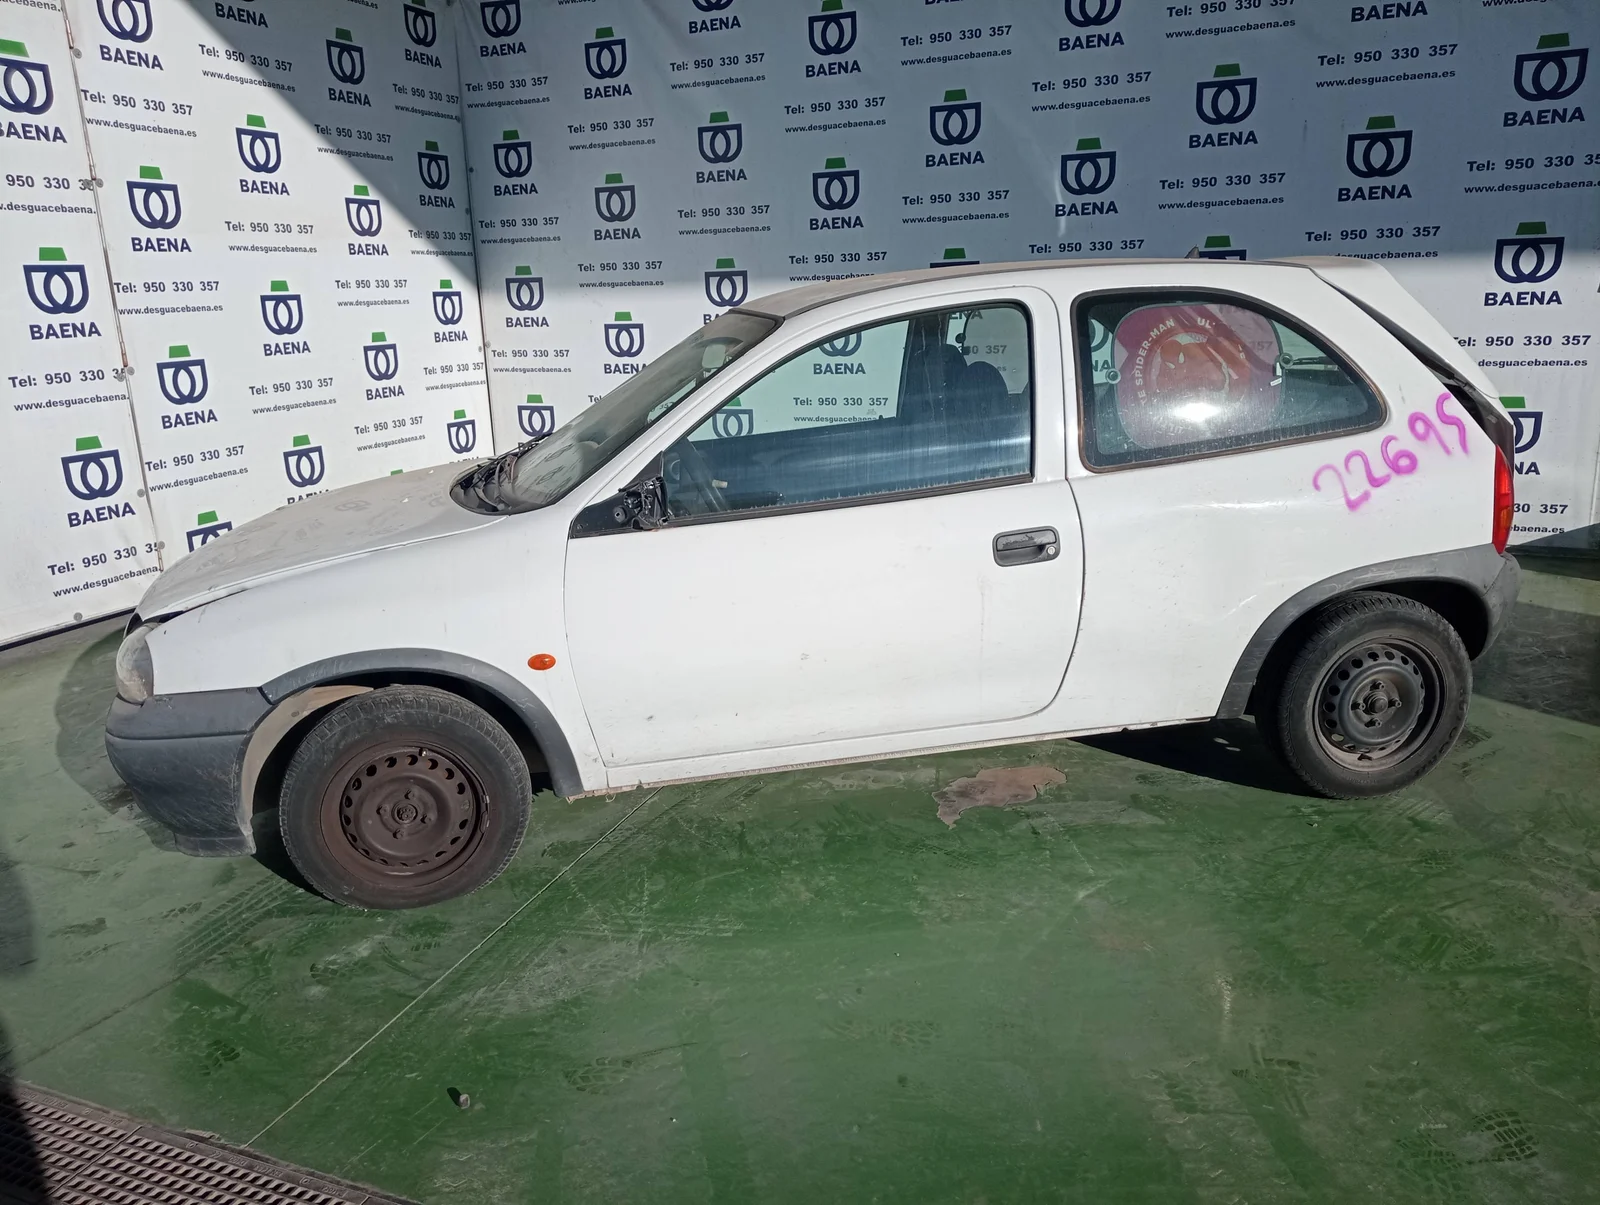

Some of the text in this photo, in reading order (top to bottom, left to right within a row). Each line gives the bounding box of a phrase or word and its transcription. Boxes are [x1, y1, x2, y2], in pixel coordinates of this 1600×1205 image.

[214, 2, 269, 29] BAENA
[1166, 5, 1193, 18] Tel:
[1200, 1, 1227, 14] 950
[1234, 0, 1261, 10] 330
[1350, 0, 1428, 23] BAENA
[688, 15, 742, 34] BAENA
[1165, 19, 1296, 39] www.desguacebaena.es
[900, 24, 1012, 47] Tel: 950 330 357
[1058, 31, 1125, 52] BAENA
[99, 44, 164, 71] BAENA
[198, 43, 293, 72] Tel: 950 330 357
[479, 41, 527, 58] BAENA
[900, 48, 1012, 66] www.desguacebaena.es
[1317, 43, 1459, 67] Tel: 950 330 357
[404, 48, 443, 69] BAENA
[669, 52, 765, 72] Tel: 950 330 357
[805, 59, 862, 78] BAENA
[201, 69, 296, 93] www.desguacebaena.es
[464, 75, 549, 92] Tel: 950 330 357
[670, 74, 766, 90] www.desguacebaena.es
[1031, 71, 1152, 93] Tel: 950 330 357
[1315, 70, 1456, 88] www.desguacebaena.es
[327, 87, 372, 108] BAENA
[583, 83, 633, 100] BAENA
[82, 88, 193, 116] Tel: 950 330 357
[466, 96, 551, 109] www.desguacebaena.es
[784, 96, 886, 115] Tel: 950 330 357
[1031, 95, 1151, 112] www.desguacebaena.es
[567, 117, 655, 134] Tel: 950 330 357
[1502, 106, 1586, 128] BAENA
[85, 115, 198, 138] www.desguacebaena.es
[784, 119, 887, 133] www.desguacebaena.es
[568, 138, 656, 151] www.desguacebaena.es
[1188, 130, 1259, 149] BAENA
[925, 150, 985, 168] BAENA
[1466, 153, 1600, 172] Tel: 950 330 35
[696, 168, 748, 184] BAENA
[1159, 172, 1286, 190] Tel: 950 330 357
[239, 178, 290, 196] BAENA
[493, 182, 539, 197] BAENA
[1337, 183, 1413, 203] BAENA
[419, 194, 456, 209] BAENA
[901, 189, 1010, 206] Tel: 950 330 357
[1158, 196, 1285, 210] www.desguacebaena.es
[677, 204, 770, 219] Tel: 950 330 357
[1054, 200, 1119, 218] BAENA
[809, 215, 865, 231] BAENA
[901, 212, 1010, 224] www.desguacebaena.es
[224, 220, 314, 235] Tel: 950 330 357
[593, 227, 642, 241] BAENA
[678, 225, 771, 236] www.desguacebaena.es
[1304, 225, 1441, 242] Tel: 950 330 357
[130, 236, 192, 253] BAENA
[347, 242, 389, 256] BAENA
[1028, 239, 1145, 254] Tel: 950 330 357
[577, 260, 663, 272] Tel: 950 330 357
[788, 251, 888, 265] Tel: 950 330 357
[114, 280, 220, 294] Tel: 950 330 357
[1483, 290, 1563, 307] BAENA
[118, 304, 224, 317] www.desguacebaena.es
[505, 316, 550, 328] BAENA
[28, 321, 102, 341] BAENA
[433, 330, 469, 343] BAENA
[263, 340, 312, 357] BAENA
[1485, 335, 1514, 347] 950
[1522, 335, 1553, 347] 330
[1561, 334, 1592, 346] 357
[491, 349, 570, 358] Tel: 950 330 357
[1135, 318, 1176, 387] SPIDER-MAN
[813, 362, 866, 375] BAENA
[1477, 358, 1588, 369] desguacebaena.es
[248, 377, 334, 396] Tel: 950 330 357
[365, 384, 405, 401] BAENA
[251, 398, 337, 415] www.desguacebaena.es
[792, 397, 889, 407] Tel: 950 330 357
[161, 408, 218, 430] BAENA
[145, 444, 245, 472] Tel: 950 330 357
[1312, 392, 1470, 512] 22695
[149, 466, 249, 493] www.desguacebaena.es
[67, 501, 136, 528] BAENA
